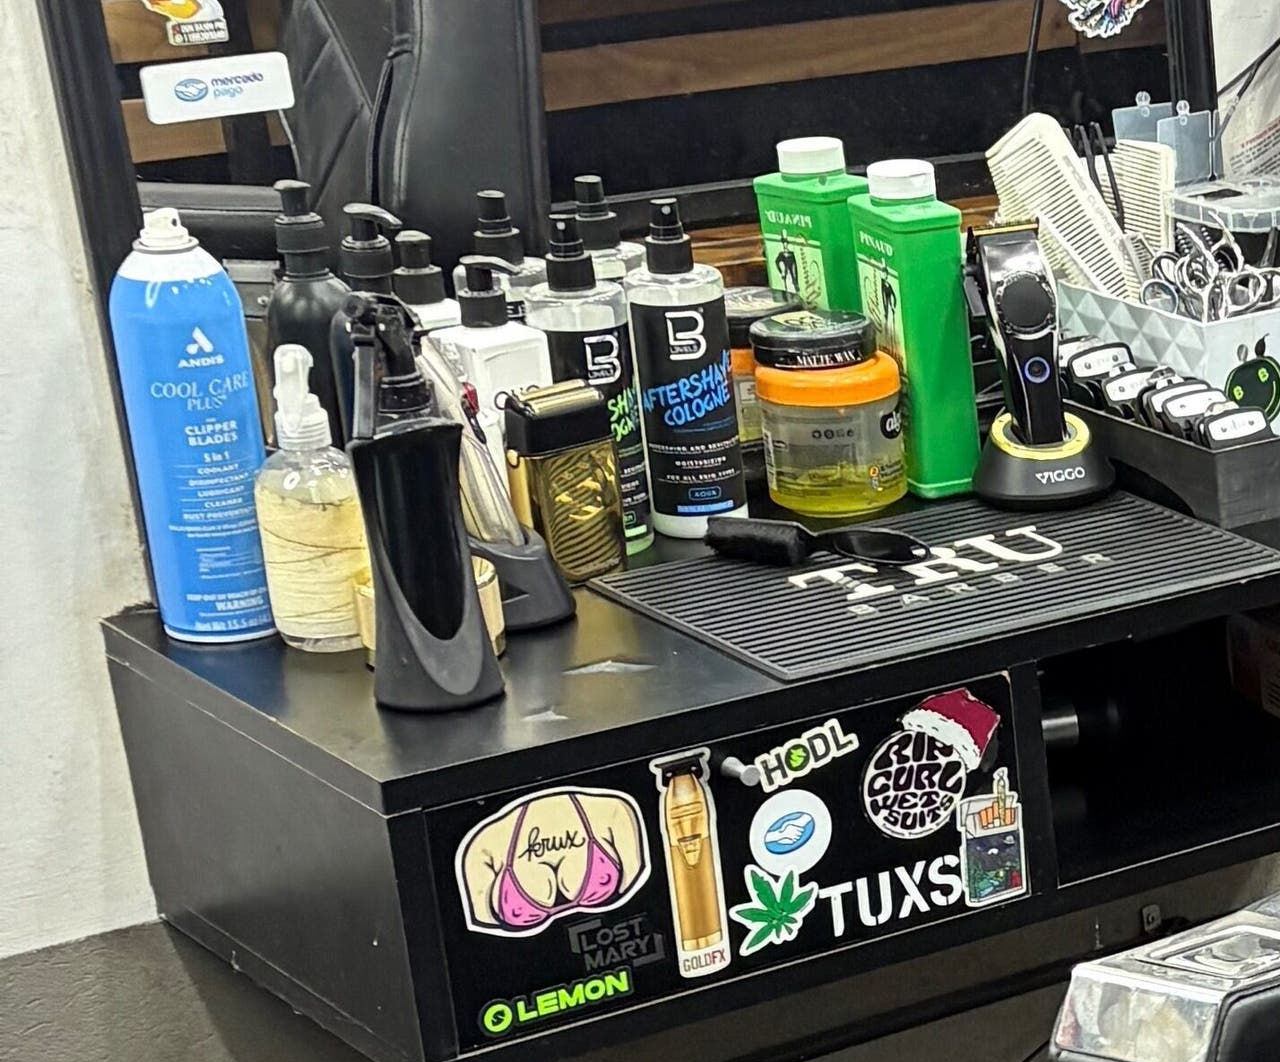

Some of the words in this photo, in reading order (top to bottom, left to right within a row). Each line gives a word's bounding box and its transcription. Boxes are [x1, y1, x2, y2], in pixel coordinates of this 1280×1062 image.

[211, 72, 264, 86] mercado
[859, 231, 894, 257] PINAUD
[178, 355, 224, 368] ANDIS
[796, 353, 835, 366] MATTE
[150, 382, 203, 398] COOL
[209, 370, 249, 396] CARE
[187, 396, 223, 411] PLUS
[664, 382, 731, 426] COLOGNE
[185, 420, 238, 436] CLIPPER
[188, 432, 239, 446] BLADES
[204, 452, 211, 463] 5
[223, 451, 230, 460] 1
[1035, 466, 1086, 485] VIGGO
[787, 524, 1064, 601] TRU
[847, 553, 1113, 615] BARBER
[760, 725, 854, 787] HODL
[868, 761, 963, 798] CURL
[818, 854, 963, 937] TUXS
[581, 916, 643, 950] LOST
[584, 934, 651, 972] MARY
[683, 949, 727, 973] GOLDFX
[516, 971, 630, 1022] LEMON
